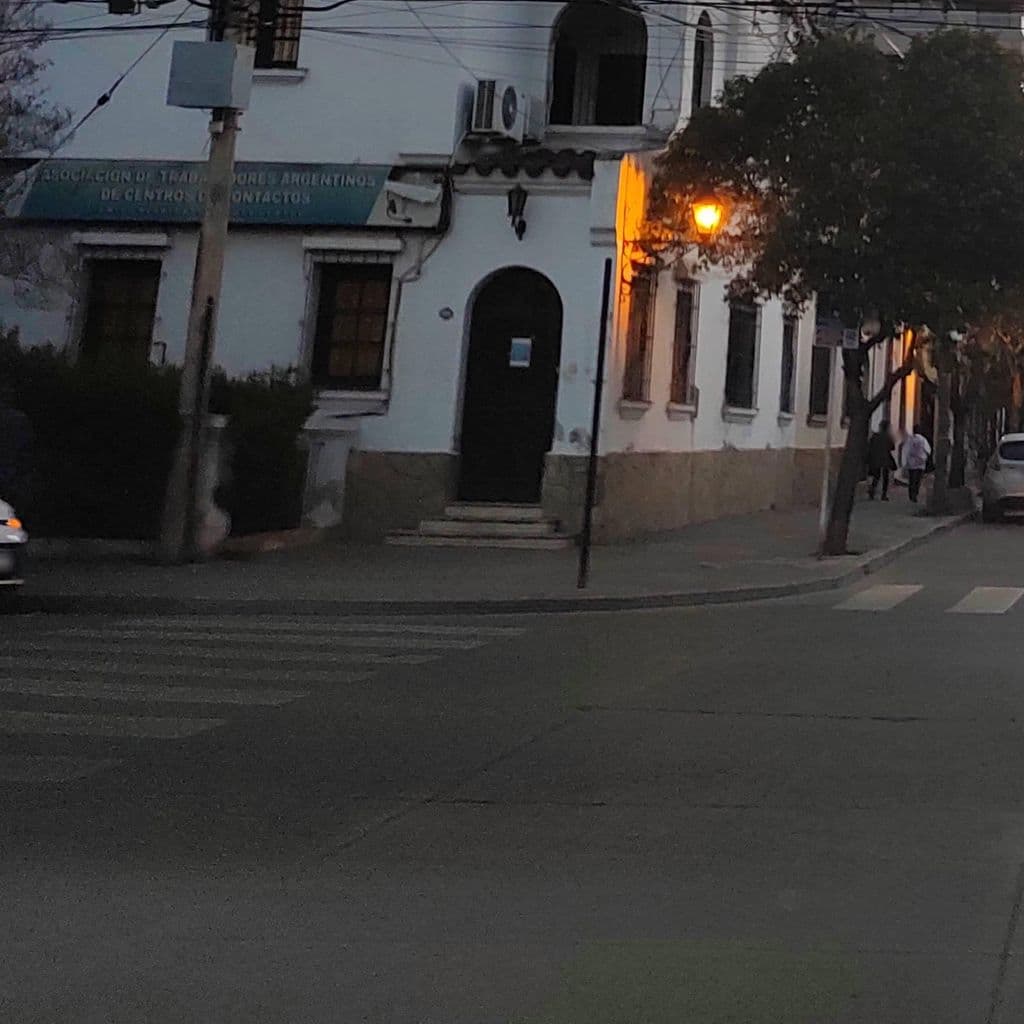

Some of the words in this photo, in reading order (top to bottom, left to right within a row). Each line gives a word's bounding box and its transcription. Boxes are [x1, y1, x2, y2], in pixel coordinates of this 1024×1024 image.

[281, 172, 376, 187] ARGENTINOS
[101, 187, 121, 201] DE
[124, 187, 192, 202] CENTROS
[229, 190, 311, 205] ONTACTOS
